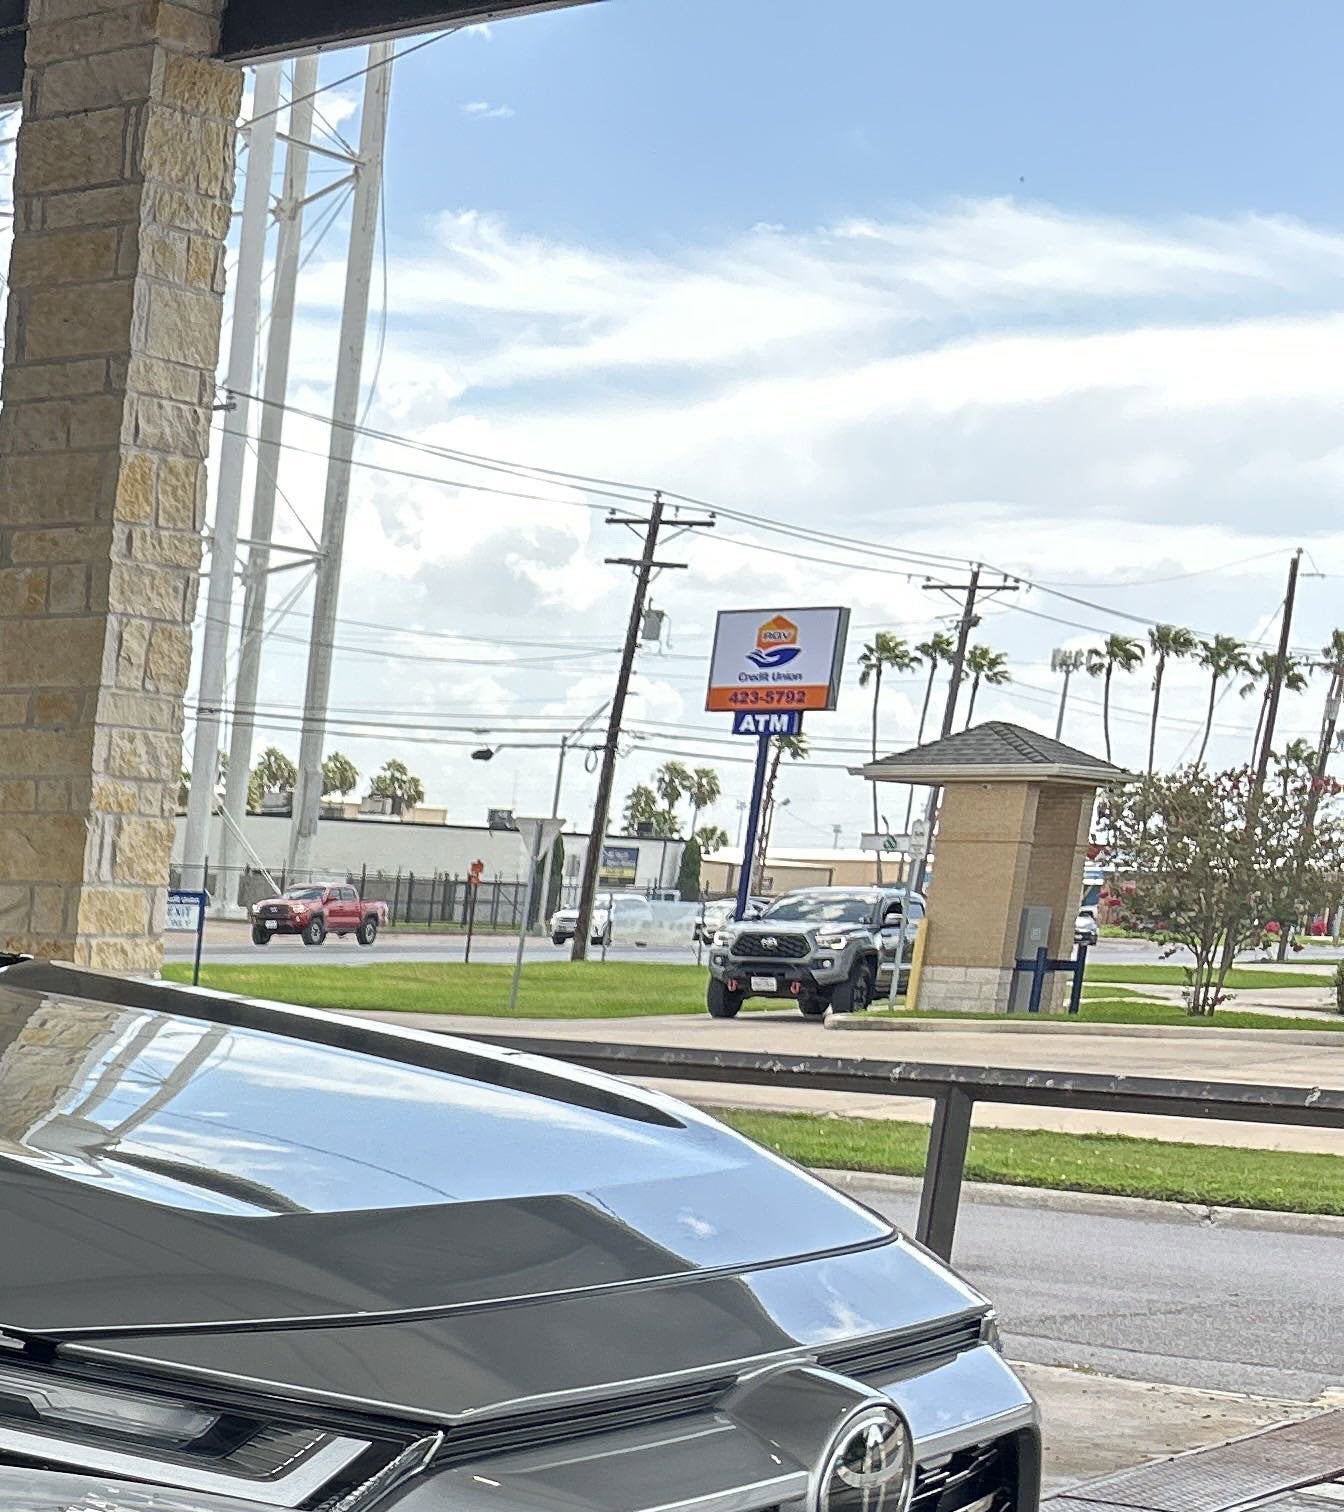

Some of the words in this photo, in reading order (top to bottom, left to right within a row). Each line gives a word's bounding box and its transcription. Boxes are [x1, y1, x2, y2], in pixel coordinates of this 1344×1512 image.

[738, 672, 769, 682] Credit
[772, 671, 802, 681] Union
[728, 690, 806, 704] 423-5792
[738, 714, 789, 733] ATM
